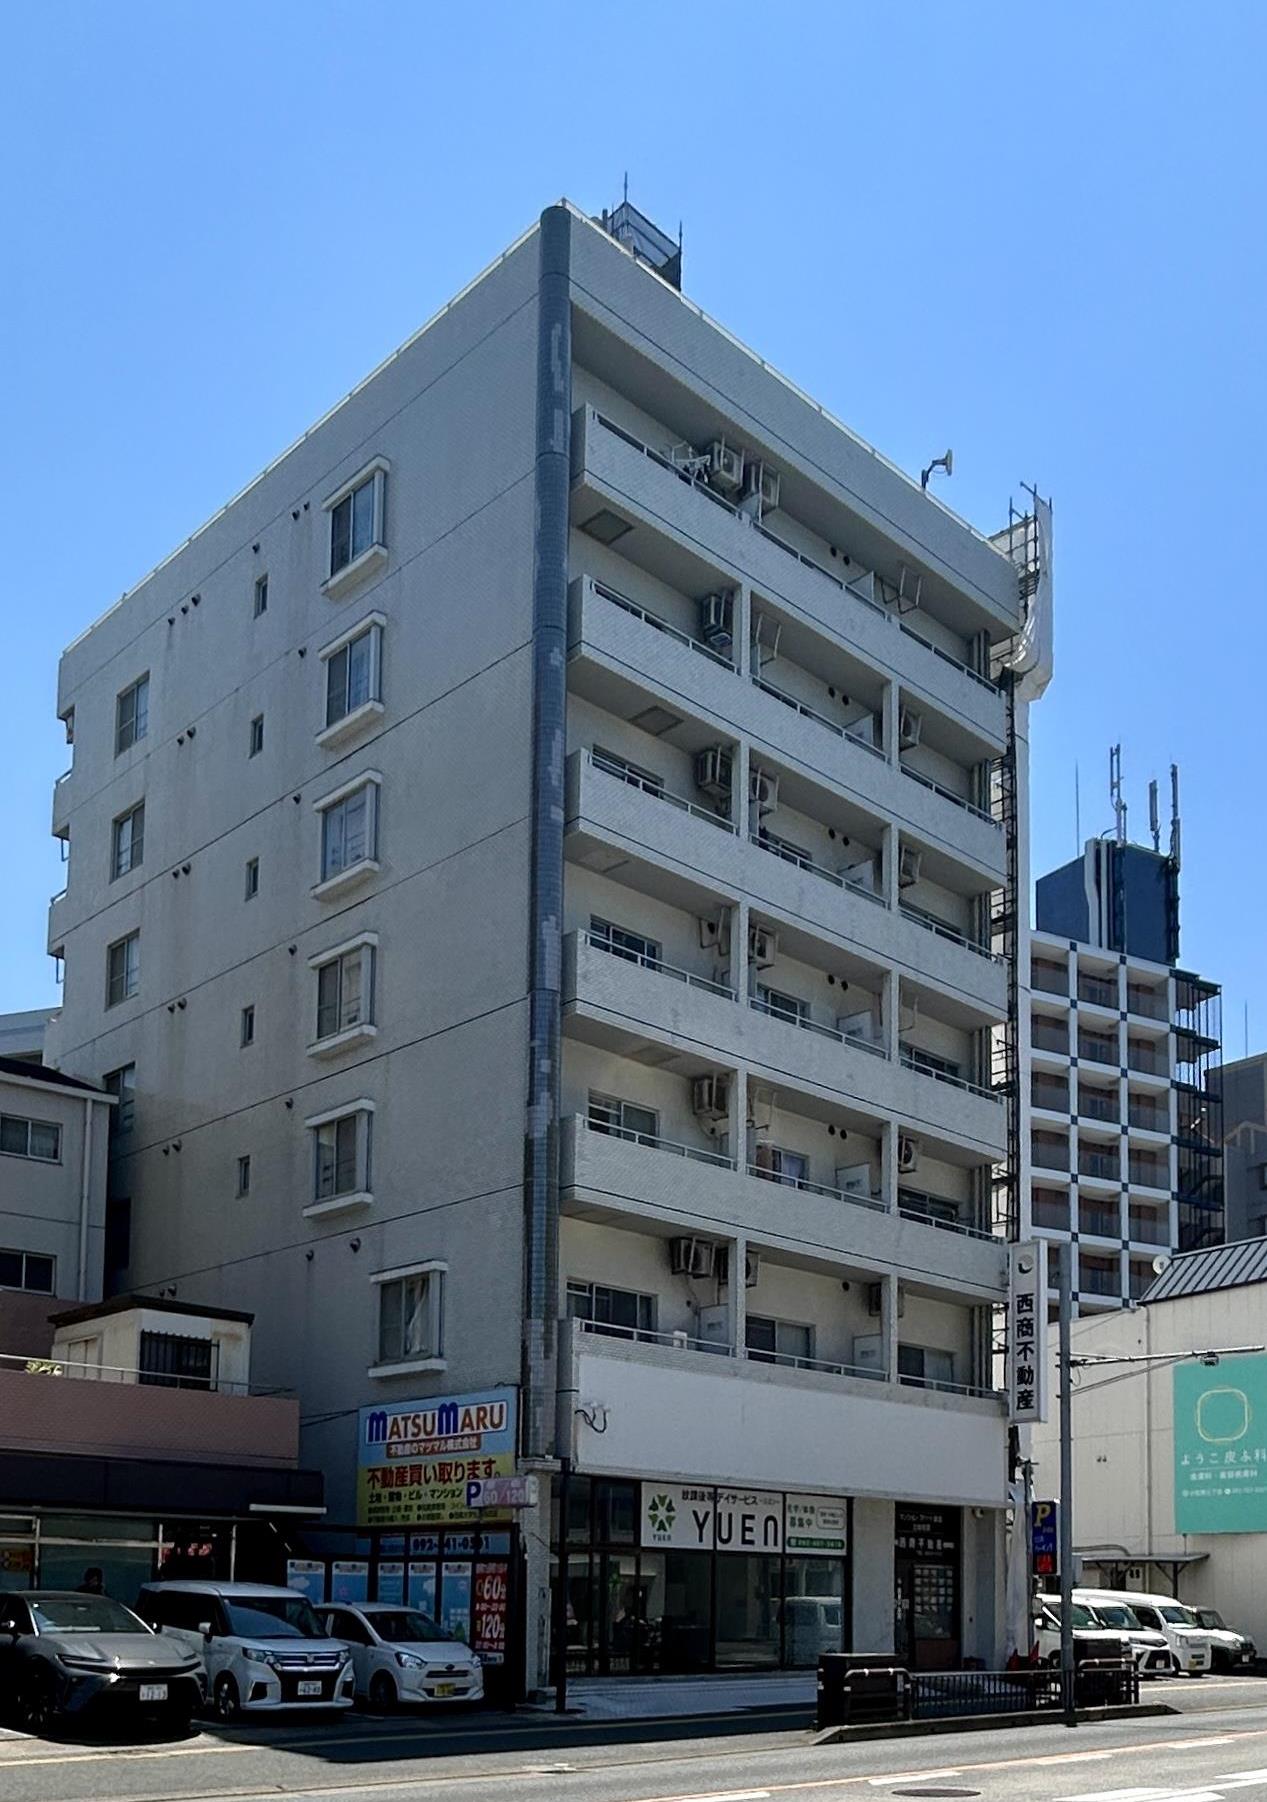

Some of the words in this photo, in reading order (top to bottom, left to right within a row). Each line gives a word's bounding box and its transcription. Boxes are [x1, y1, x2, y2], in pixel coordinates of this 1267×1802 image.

[1016, 1293, 1034, 1410] 西商不動産
[368, 1402, 504, 1442] MATSUMARU
[467, 1482, 481, 1506] P
[1034, 1504, 1051, 1527] P
